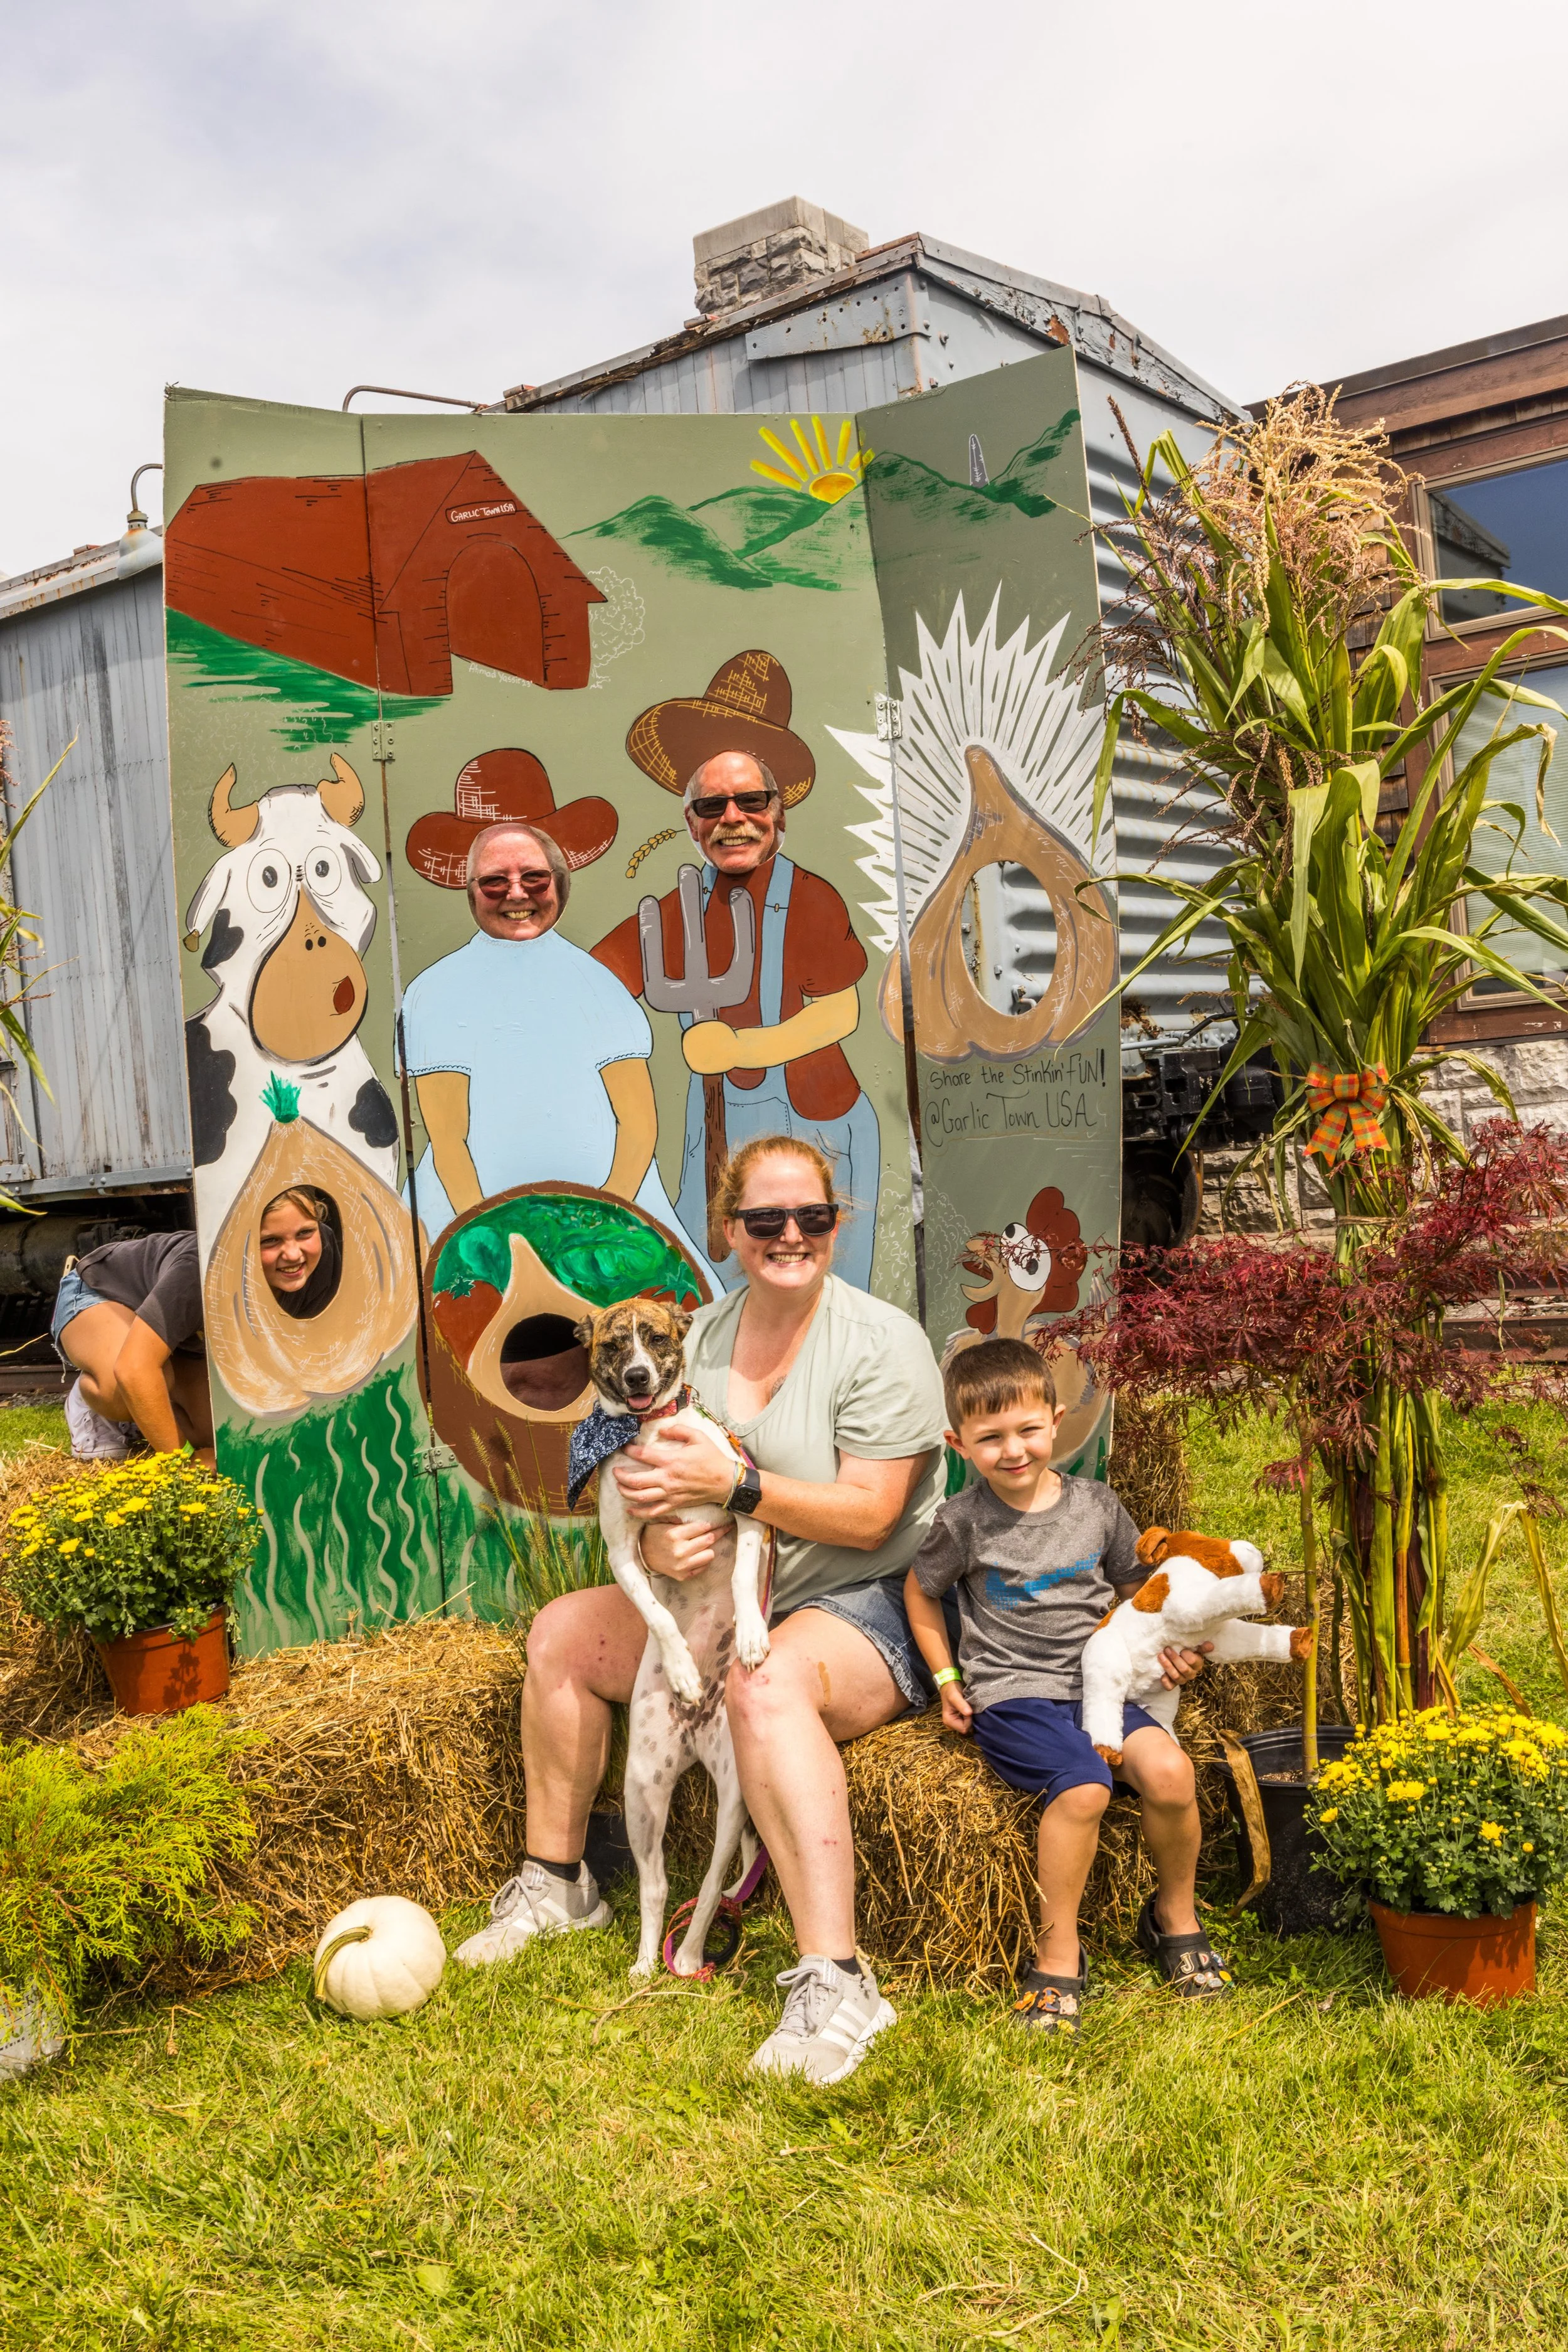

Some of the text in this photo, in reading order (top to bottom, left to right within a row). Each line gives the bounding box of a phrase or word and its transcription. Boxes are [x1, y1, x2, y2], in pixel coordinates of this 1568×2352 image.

[450, 509, 480, 522] GARLIC
[500, 503, 516, 513] USA
[469, 662, 497, 678] Ahmad
[930, 1070, 972, 1090] Share
[981, 1066, 1004, 1084] the
[1066, 1048, 1106, 1087] FUN!
[924, 1089, 1097, 1147] @Garlic Town USA
